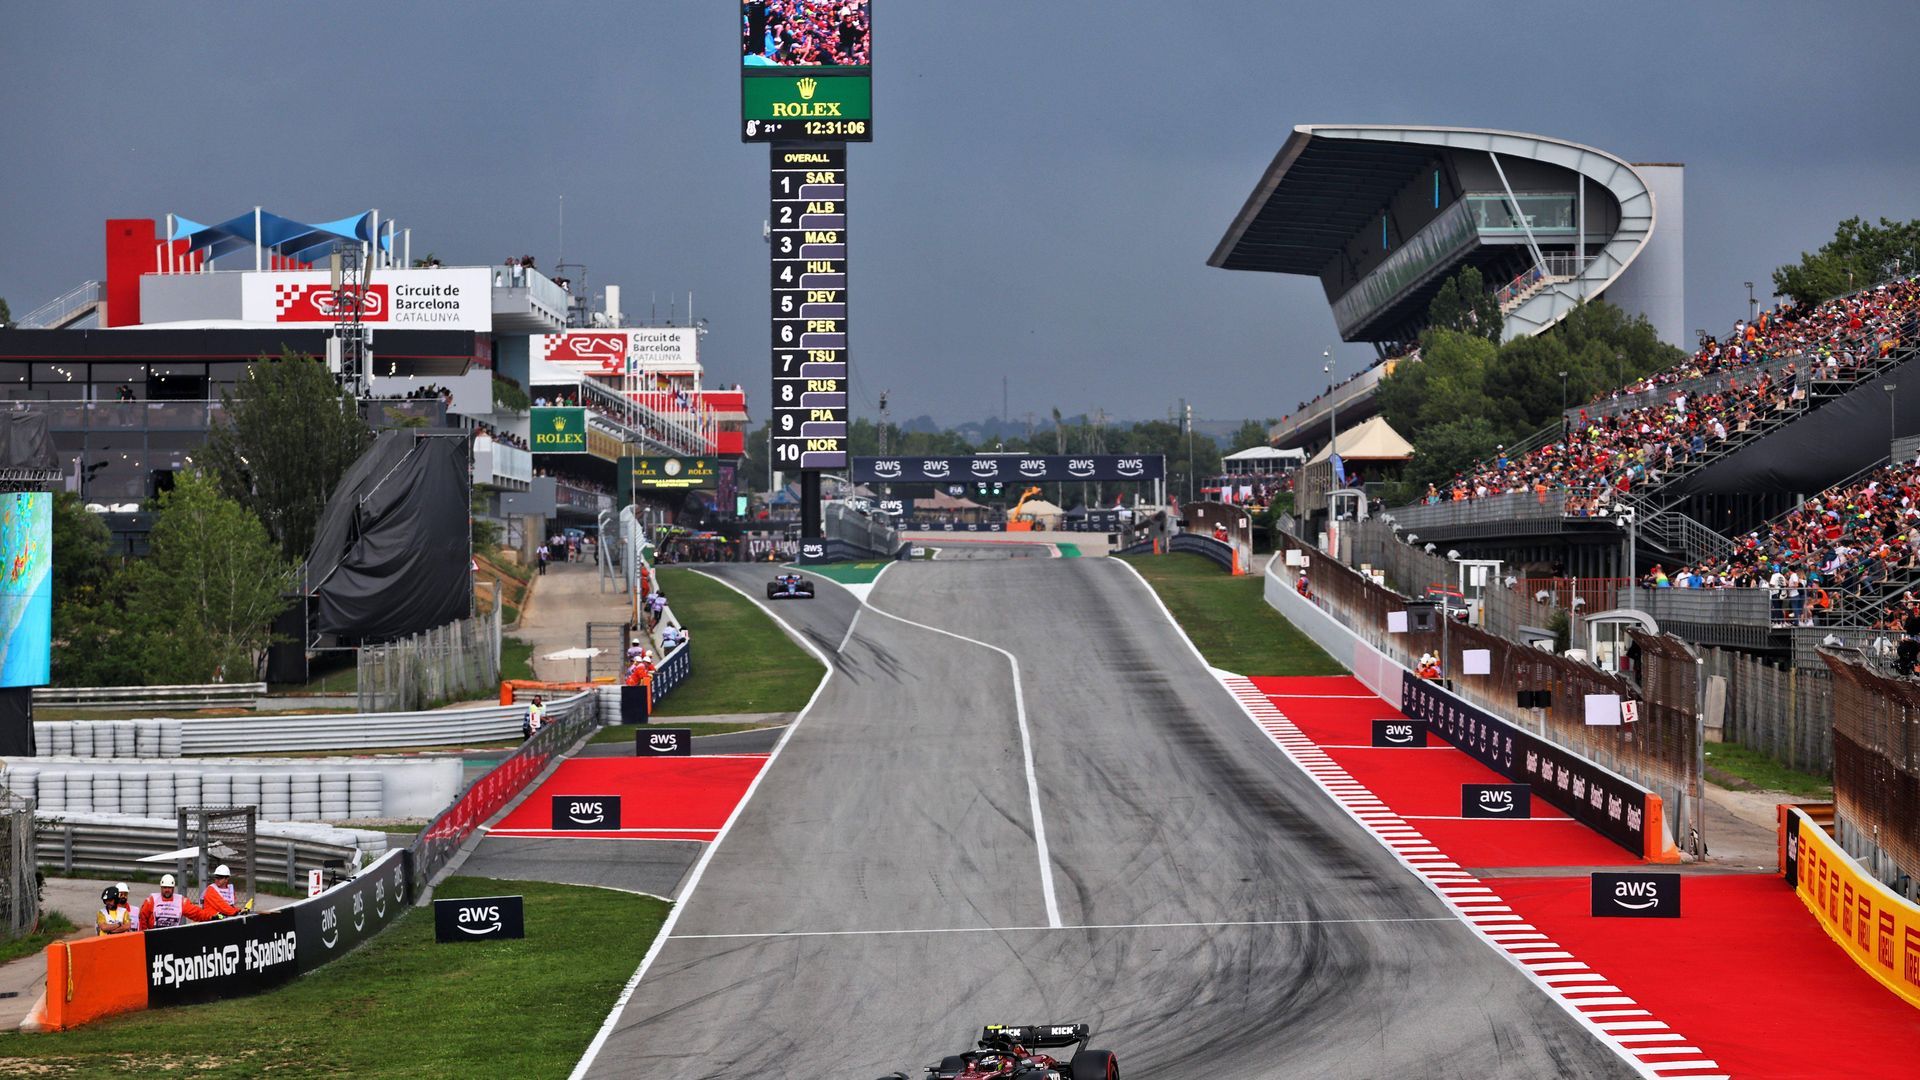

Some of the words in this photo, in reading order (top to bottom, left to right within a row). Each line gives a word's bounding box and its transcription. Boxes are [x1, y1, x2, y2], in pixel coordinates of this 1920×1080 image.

[773, 102, 841, 117] ROLEX
[804, 121, 865, 135] 12:31:06
[784, 153, 830, 163] OVERALL
[780, 176, 790, 194] 1
[806, 172, 835, 184] SAR
[780, 206, 792, 224] 2
[806, 202, 835, 214] ALB
[780, 236, 792, 253] 3
[805, 232, 837, 243] MAG
[780, 265, 793, 282] 4
[807, 261, 835, 273] HUL
[395, 284, 441, 297] Circuit
[443, 284, 460, 296] de
[396, 298, 460, 310] Barcelona
[781, 295, 793, 312] 5
[807, 291, 836, 303] DEV
[395, 312, 460, 323] CATALUNYA
[633, 333, 667, 342] Circuit
[668, 333, 681, 342] de
[781, 325, 793, 342] 6
[807, 320, 836, 332] PER
[633, 343, 681, 352] Barcelona
[781, 354, 794, 371] 7
[808, 350, 836, 362] TSU
[781, 384, 794, 401] 8
[807, 380, 837, 392] RUS
[781, 414, 794, 431] 9
[810, 409, 834, 421] PIA
[536, 433, 583, 444] ROLEX
[777, 444, 799, 461] 10
[807, 439, 837, 451] NOR
[875, 460, 901, 471] aws
[923, 460, 949, 471] aws
[972, 459, 998, 470] aws
[1020, 459, 1046, 470] aws
[1069, 459, 1095, 470] aws
[1118, 458, 1143, 469] aws
[880, 500, 903, 509] aws
[803, 544, 823, 553] aws
[1386, 725, 1413, 736] aws
[650, 734, 677, 745] aws
[1480, 790, 1513, 803] aws
[570, 802, 603, 815] aws
[1615, 881, 1657, 897] aws
[321, 905, 338, 933] aws
[458, 906, 500, 923] aws
[152, 944, 240, 988] #SpanishGP
[245, 930, 297, 973] #SpanishGP
[1051, 1026, 1074, 1036] KICK
